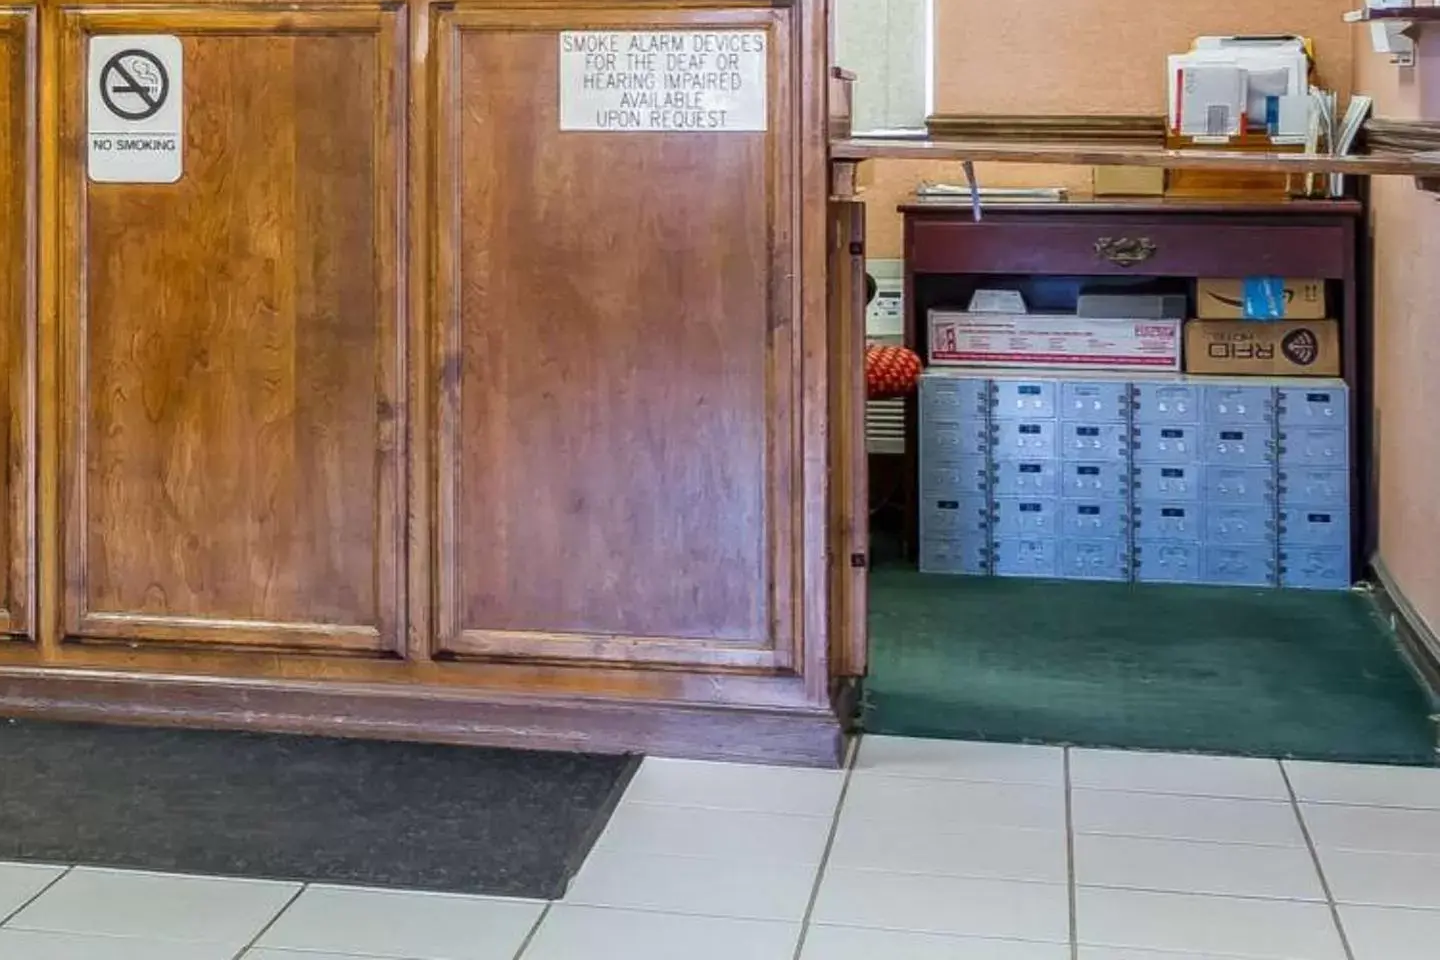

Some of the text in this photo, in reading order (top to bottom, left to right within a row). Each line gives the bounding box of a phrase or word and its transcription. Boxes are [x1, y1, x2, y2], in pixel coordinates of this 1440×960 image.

[563, 34, 764, 53] SMOKE ALARM DEVICES
[585, 53, 740, 72] FOR THE DEAF OR
[583, 72, 742, 91] HEARING IMPAIRED
[619, 92, 704, 110] AVAILABLE
[596, 110, 728, 129] UPON REQUEST
[93, 139, 176, 151] NO SMOKING
[1208, 342, 1275, 360] RFID
